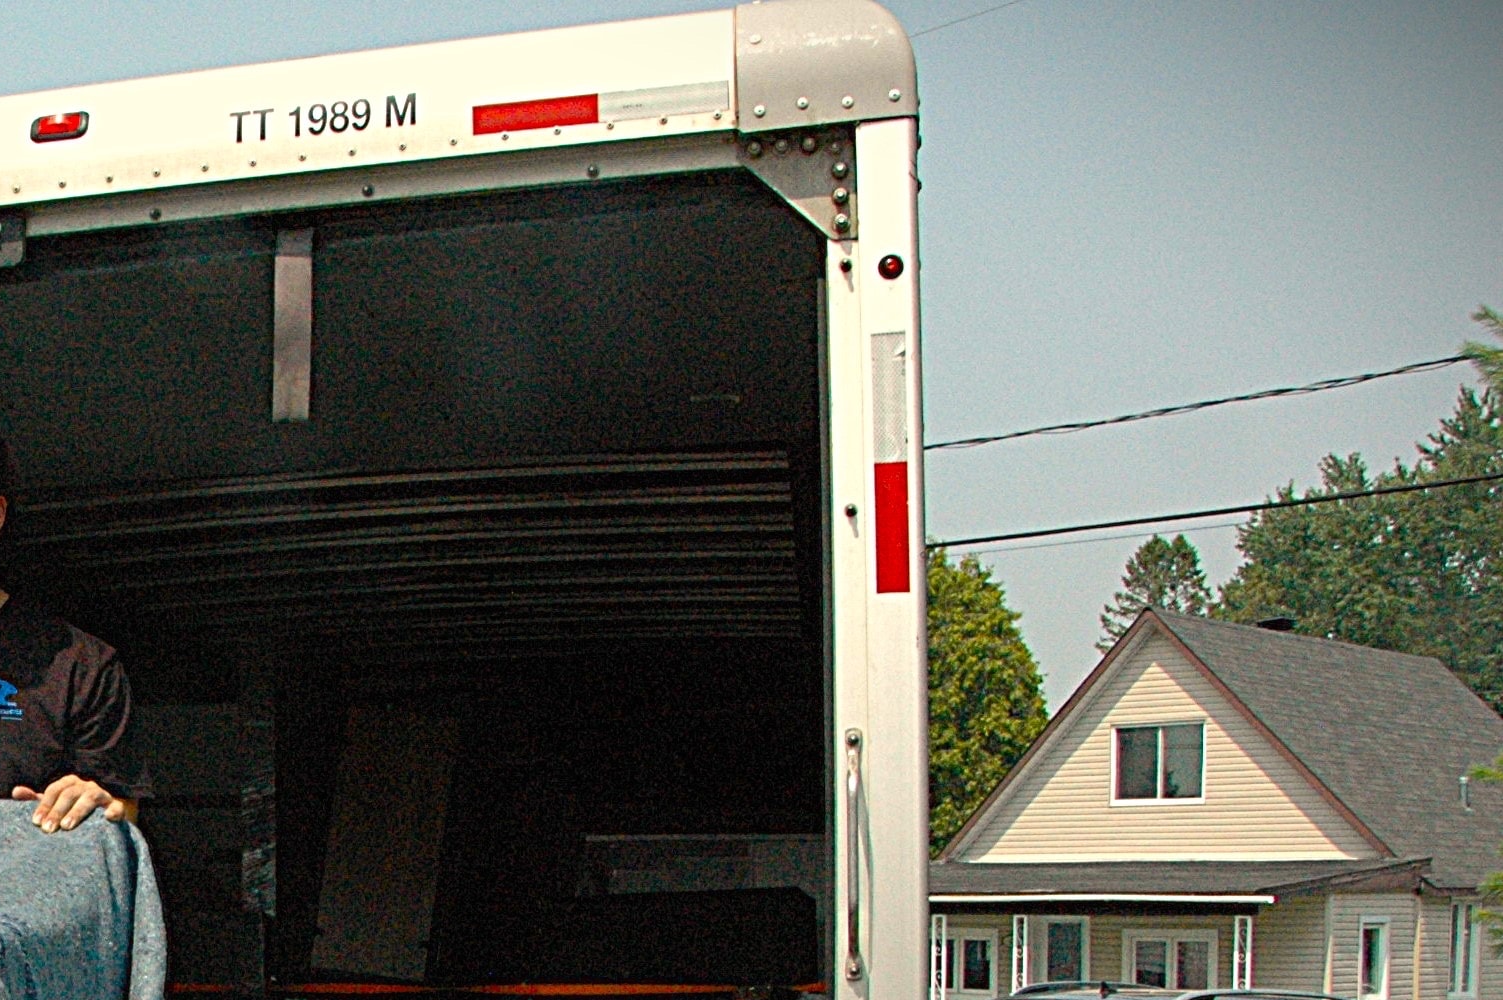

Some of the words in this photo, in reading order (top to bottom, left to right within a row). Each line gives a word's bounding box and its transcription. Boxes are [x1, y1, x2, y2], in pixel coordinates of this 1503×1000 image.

[229, 108, 274, 143] TT
[289, 98, 371, 137] 1989
[386, 93, 416, 128] M
